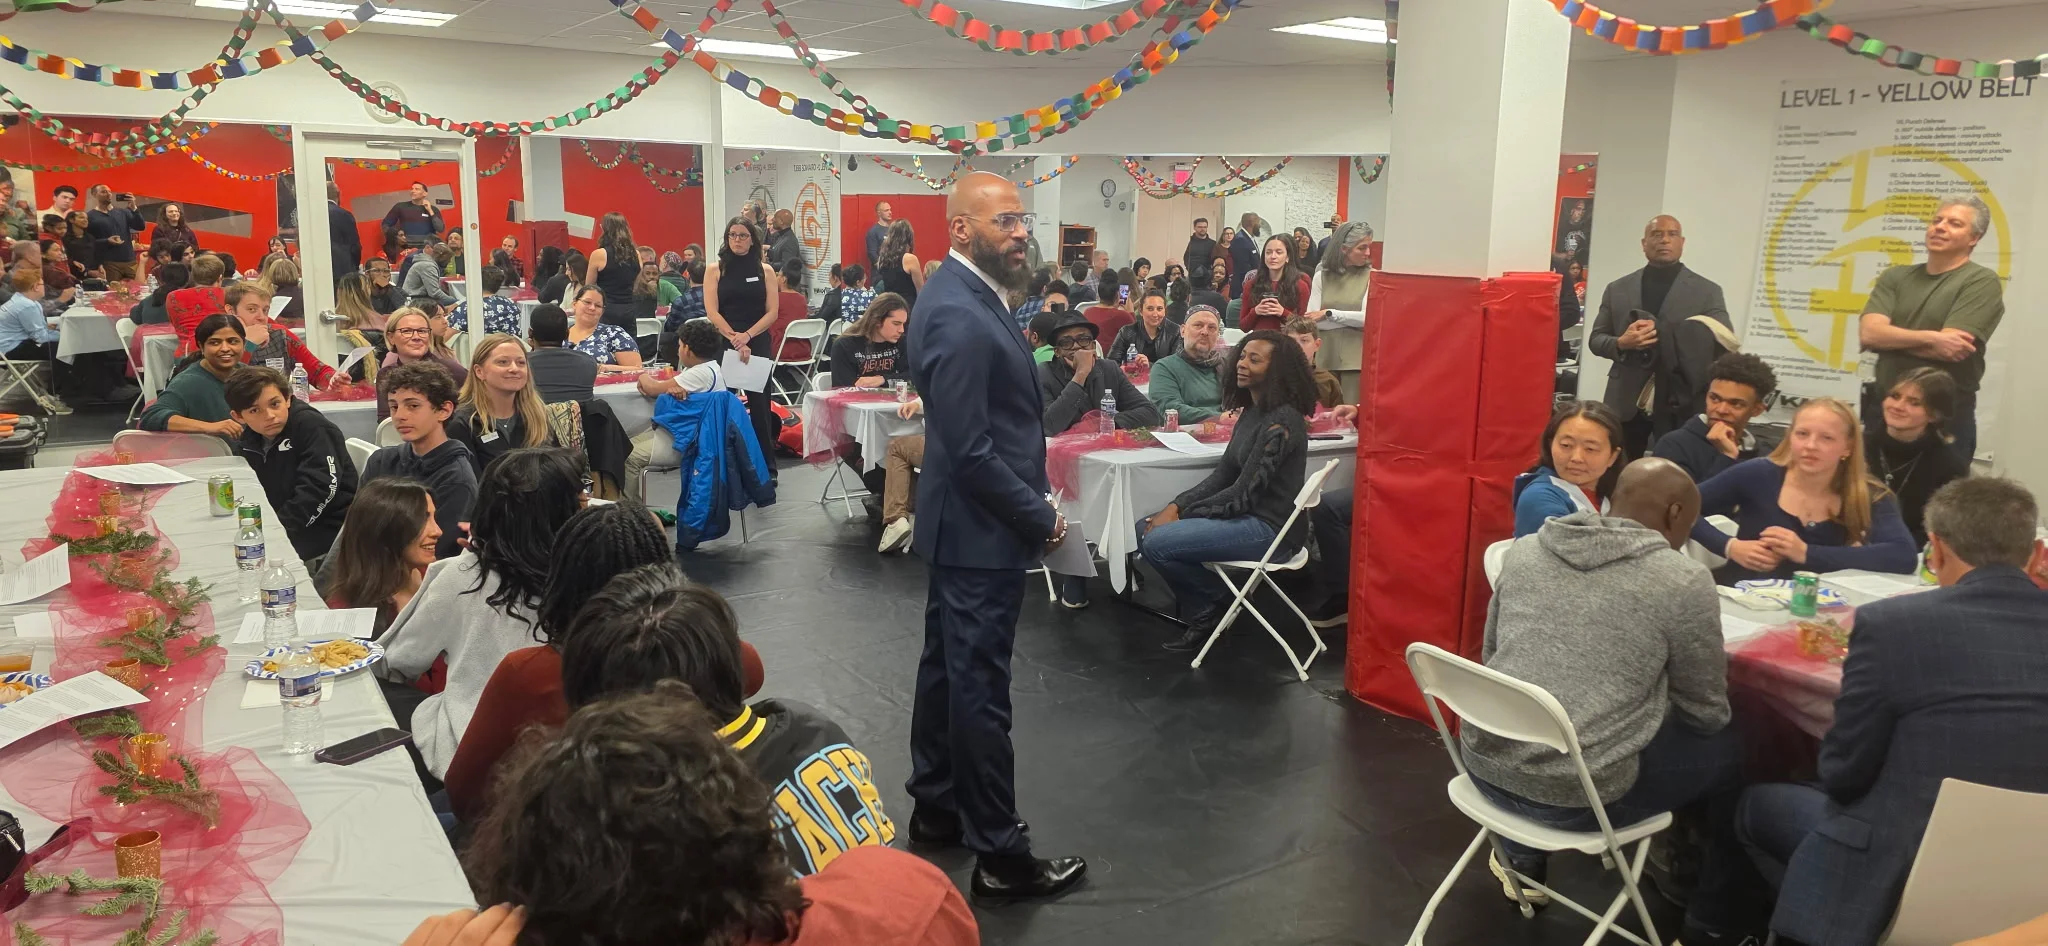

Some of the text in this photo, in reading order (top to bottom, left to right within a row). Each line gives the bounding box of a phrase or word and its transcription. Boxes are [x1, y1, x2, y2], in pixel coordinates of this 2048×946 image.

[1780, 88, 1842, 108] LEVEL
[1848, 89, 1855, 104] 1
[1877, 79, 1972, 102] YELLOW
[1979, 76, 2037, 98] BELT
